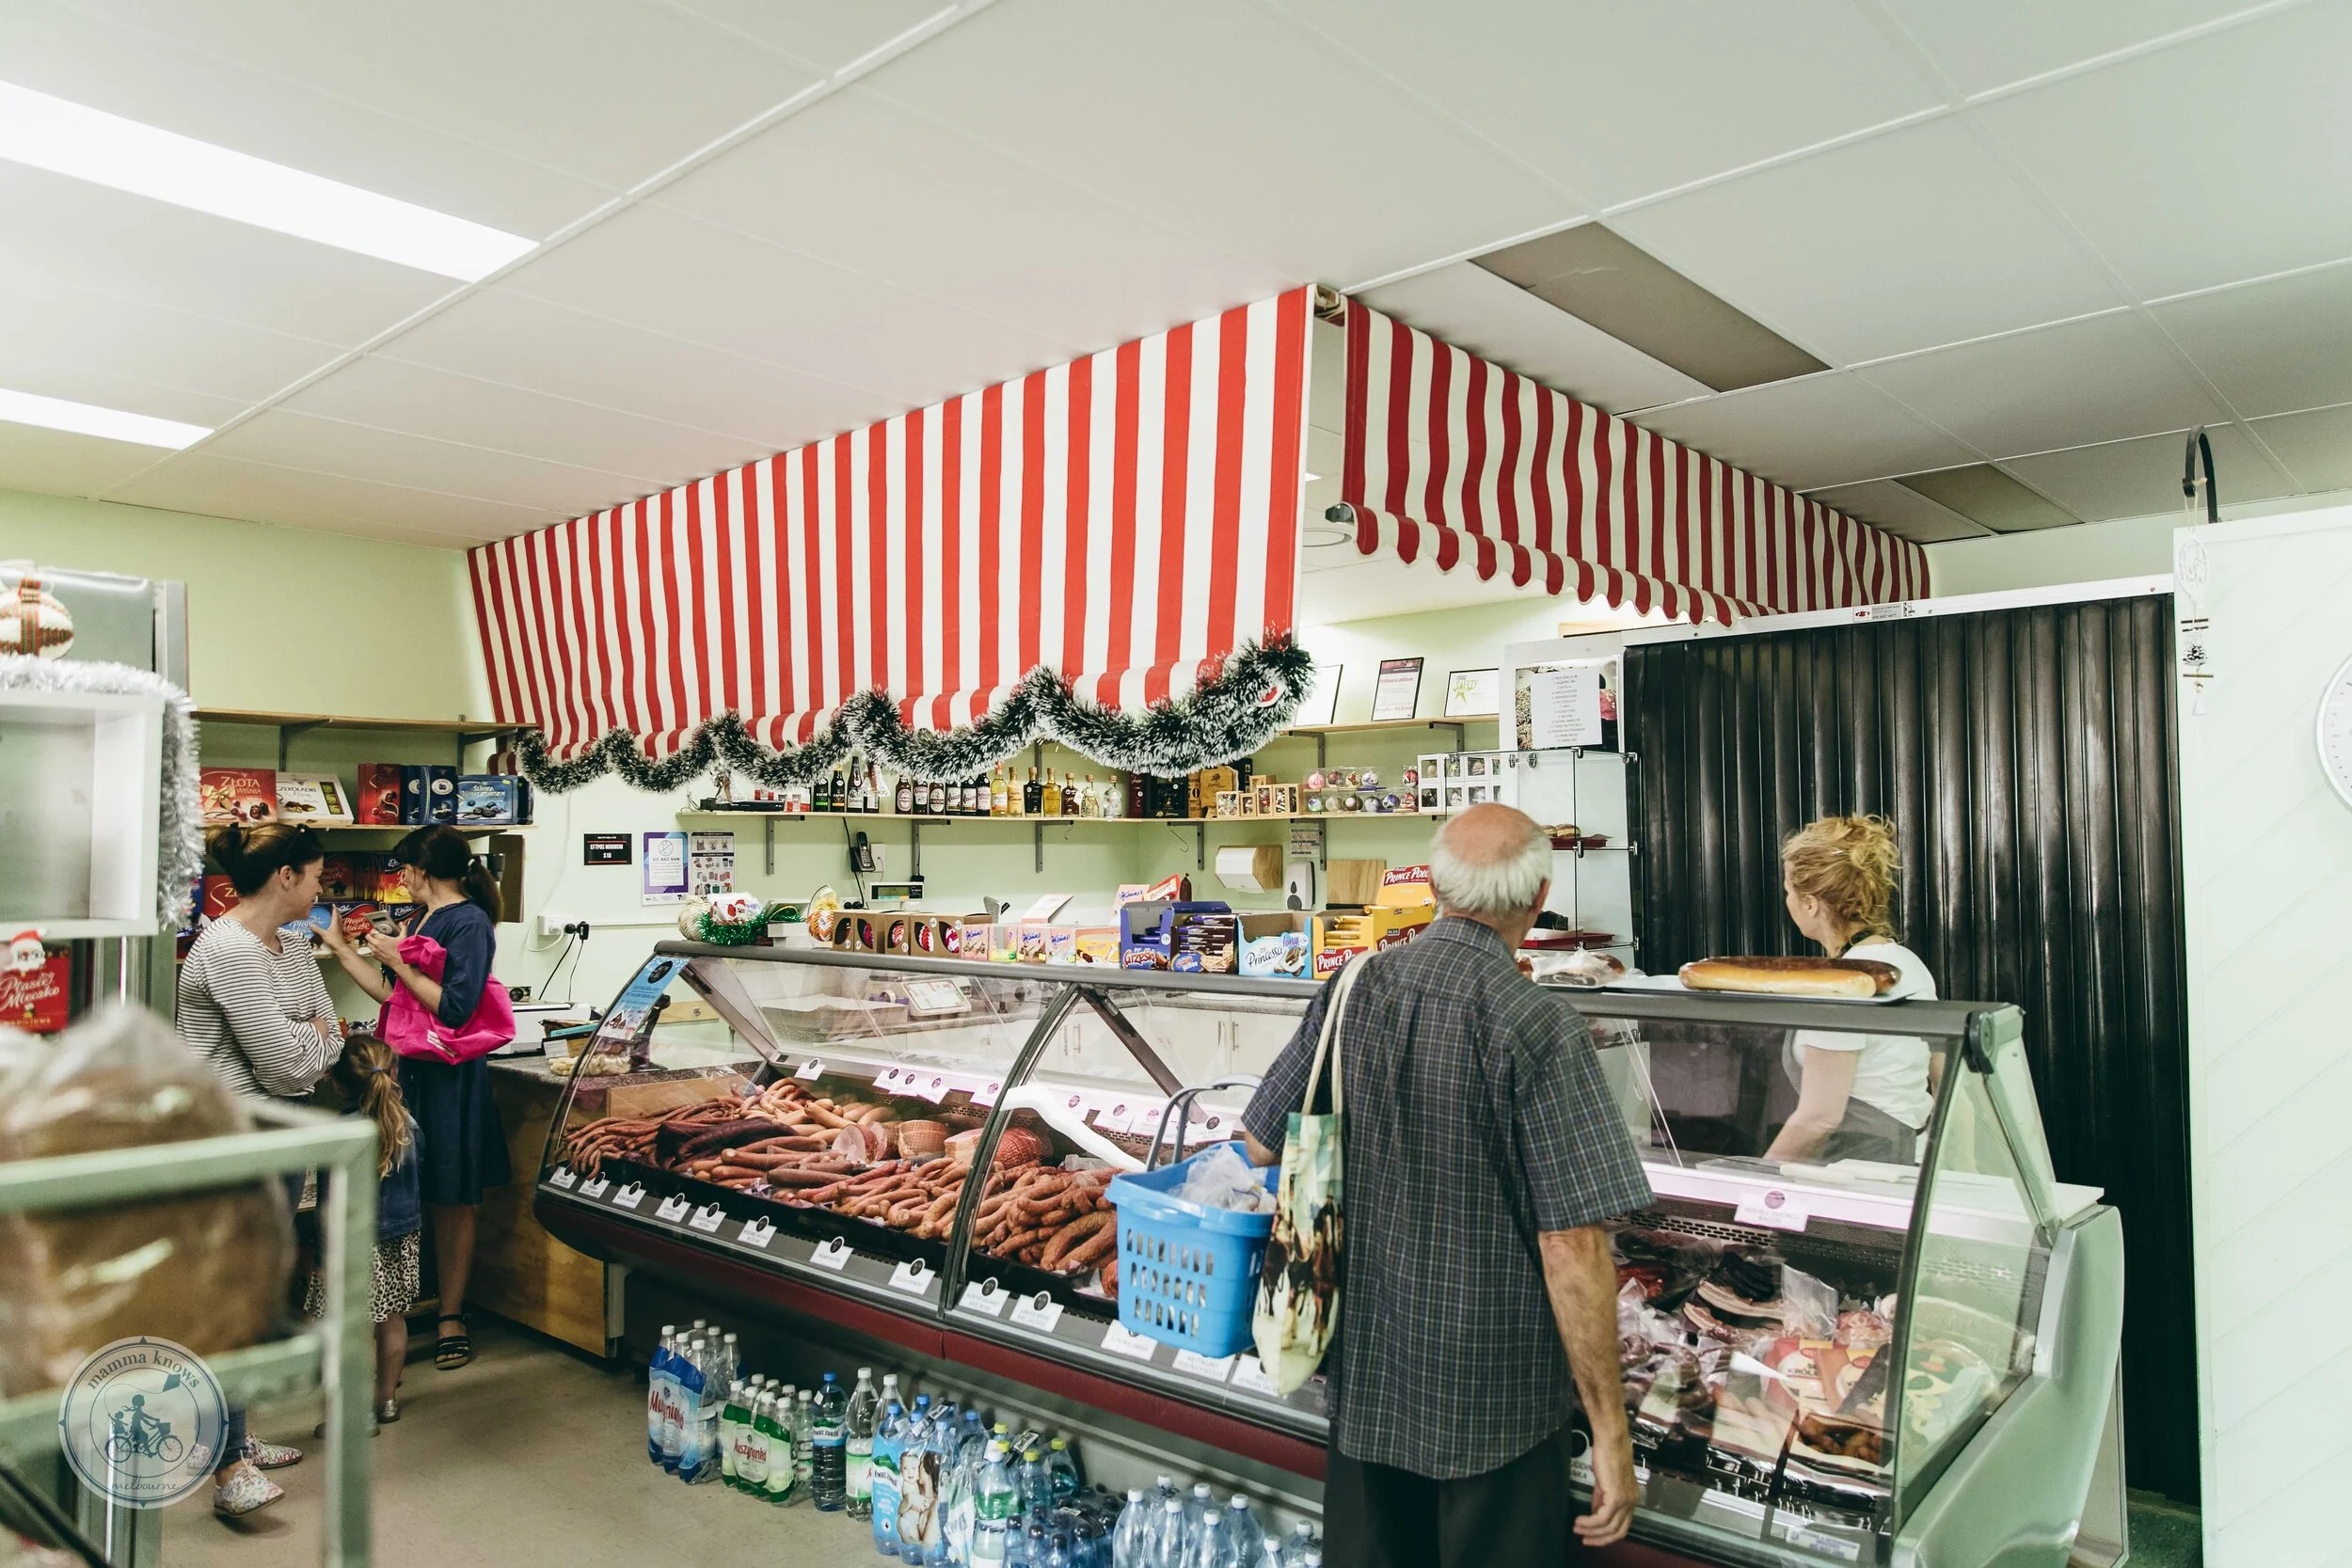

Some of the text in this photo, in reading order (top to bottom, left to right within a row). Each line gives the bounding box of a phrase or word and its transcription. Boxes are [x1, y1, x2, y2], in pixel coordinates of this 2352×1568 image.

[1385, 869, 1410, 884] PRINCE
[1246, 946, 1284, 967] Princessa
[1317, 954, 1343, 971] PRINCE
